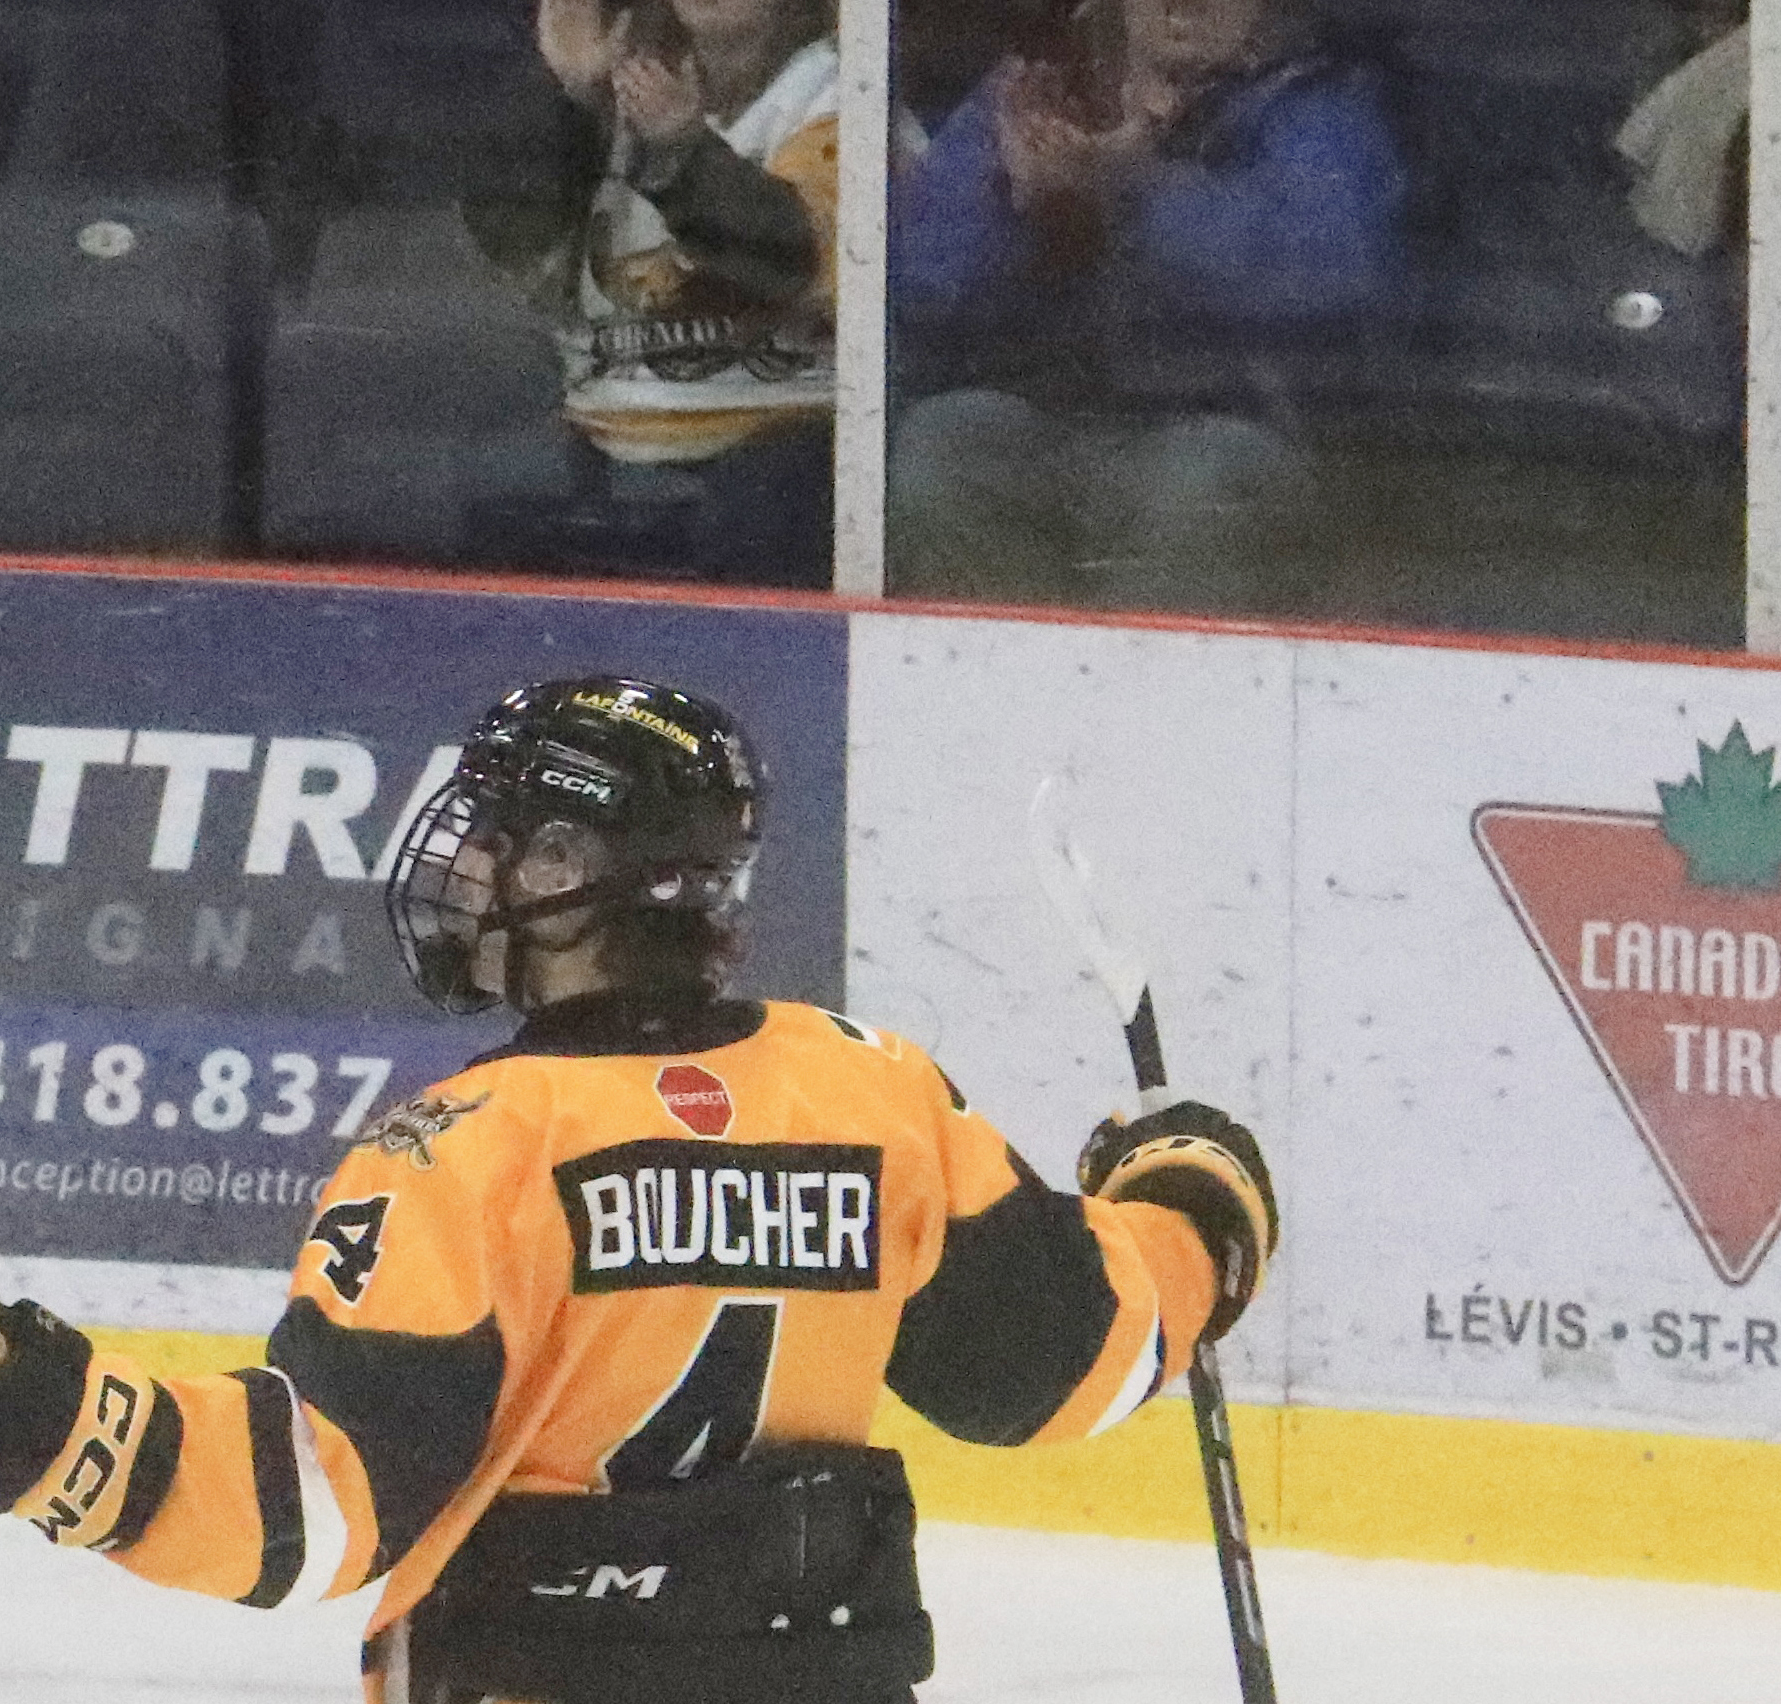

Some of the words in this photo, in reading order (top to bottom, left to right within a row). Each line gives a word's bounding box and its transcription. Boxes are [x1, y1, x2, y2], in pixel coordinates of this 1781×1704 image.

[540, 768, 612, 804] CCM
[307, 1193, 395, 1307] 4
[580, 1166, 872, 1273] BOUCHER
[1424, 1281, 1589, 1351] LÉVIS
[29, 1371, 139, 1547] CCM
